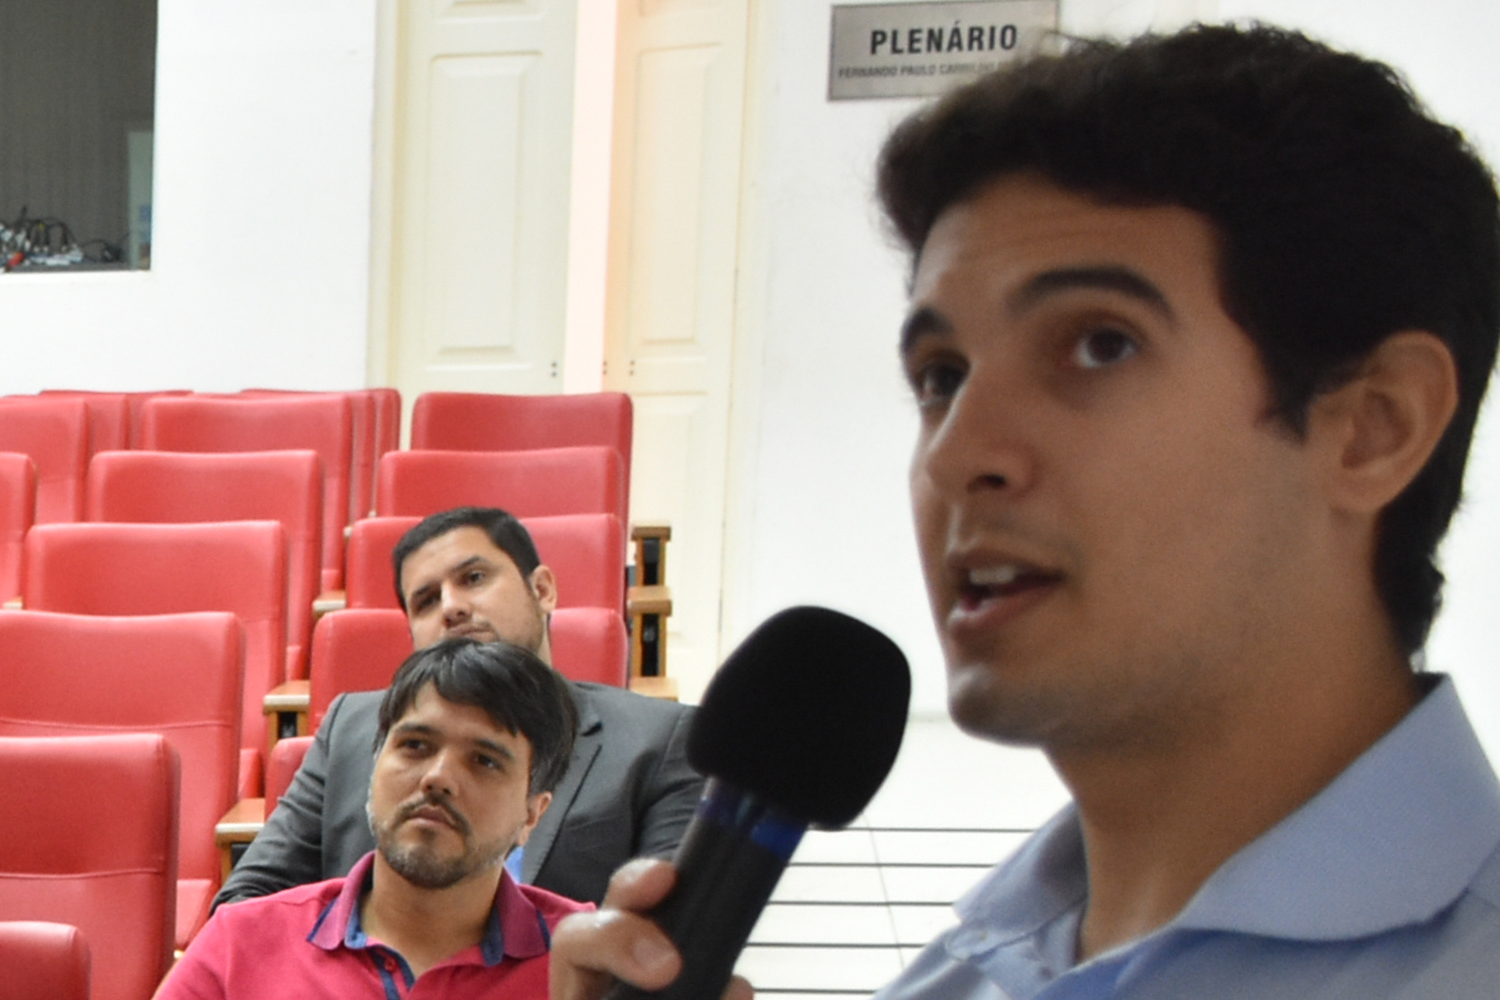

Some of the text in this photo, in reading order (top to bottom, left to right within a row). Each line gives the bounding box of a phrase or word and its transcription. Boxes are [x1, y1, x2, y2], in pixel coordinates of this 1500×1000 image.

[870, 20, 1018, 55] PLENÁRIO
[838, 65, 897, 79] FERNANDO
[900, 64, 936, 77] PAULO
